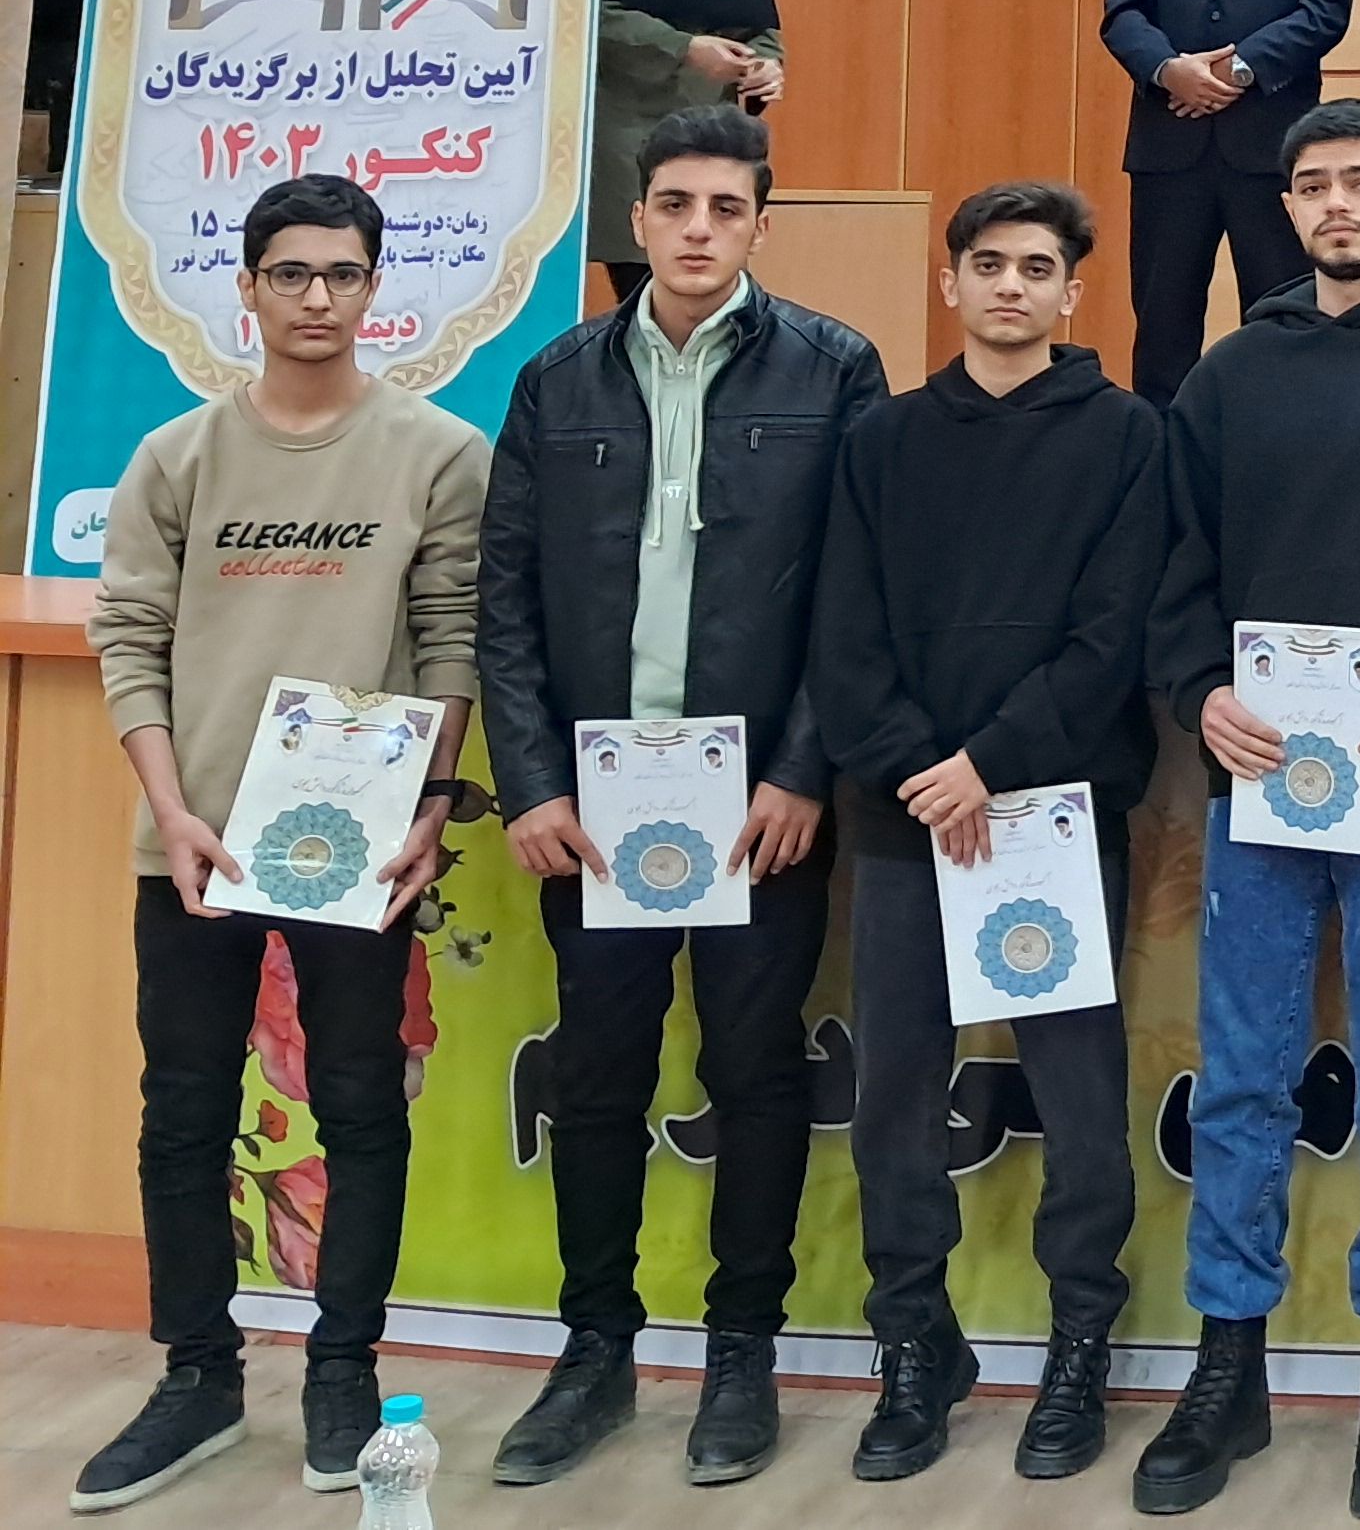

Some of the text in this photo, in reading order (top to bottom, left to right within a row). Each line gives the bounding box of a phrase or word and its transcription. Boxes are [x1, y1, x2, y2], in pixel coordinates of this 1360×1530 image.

[325, 50, 357, 100] از
[365, 49, 456, 99] تجلیل
[463, 45, 539, 99] آیین
[200, 121, 492, 190] کنکور ۱۴۰۳
[191, 209, 219, 238] ۱۵
[170, 249, 196, 272] نور
[200, 249, 237, 271] سالن
[377, 247, 397, 269] پار
[401, 245, 435, 268] پشت
[449, 245, 486, 267] مکان
[215, 521, 381, 550] ELEGANCE
[219, 553, 344, 577] collection
